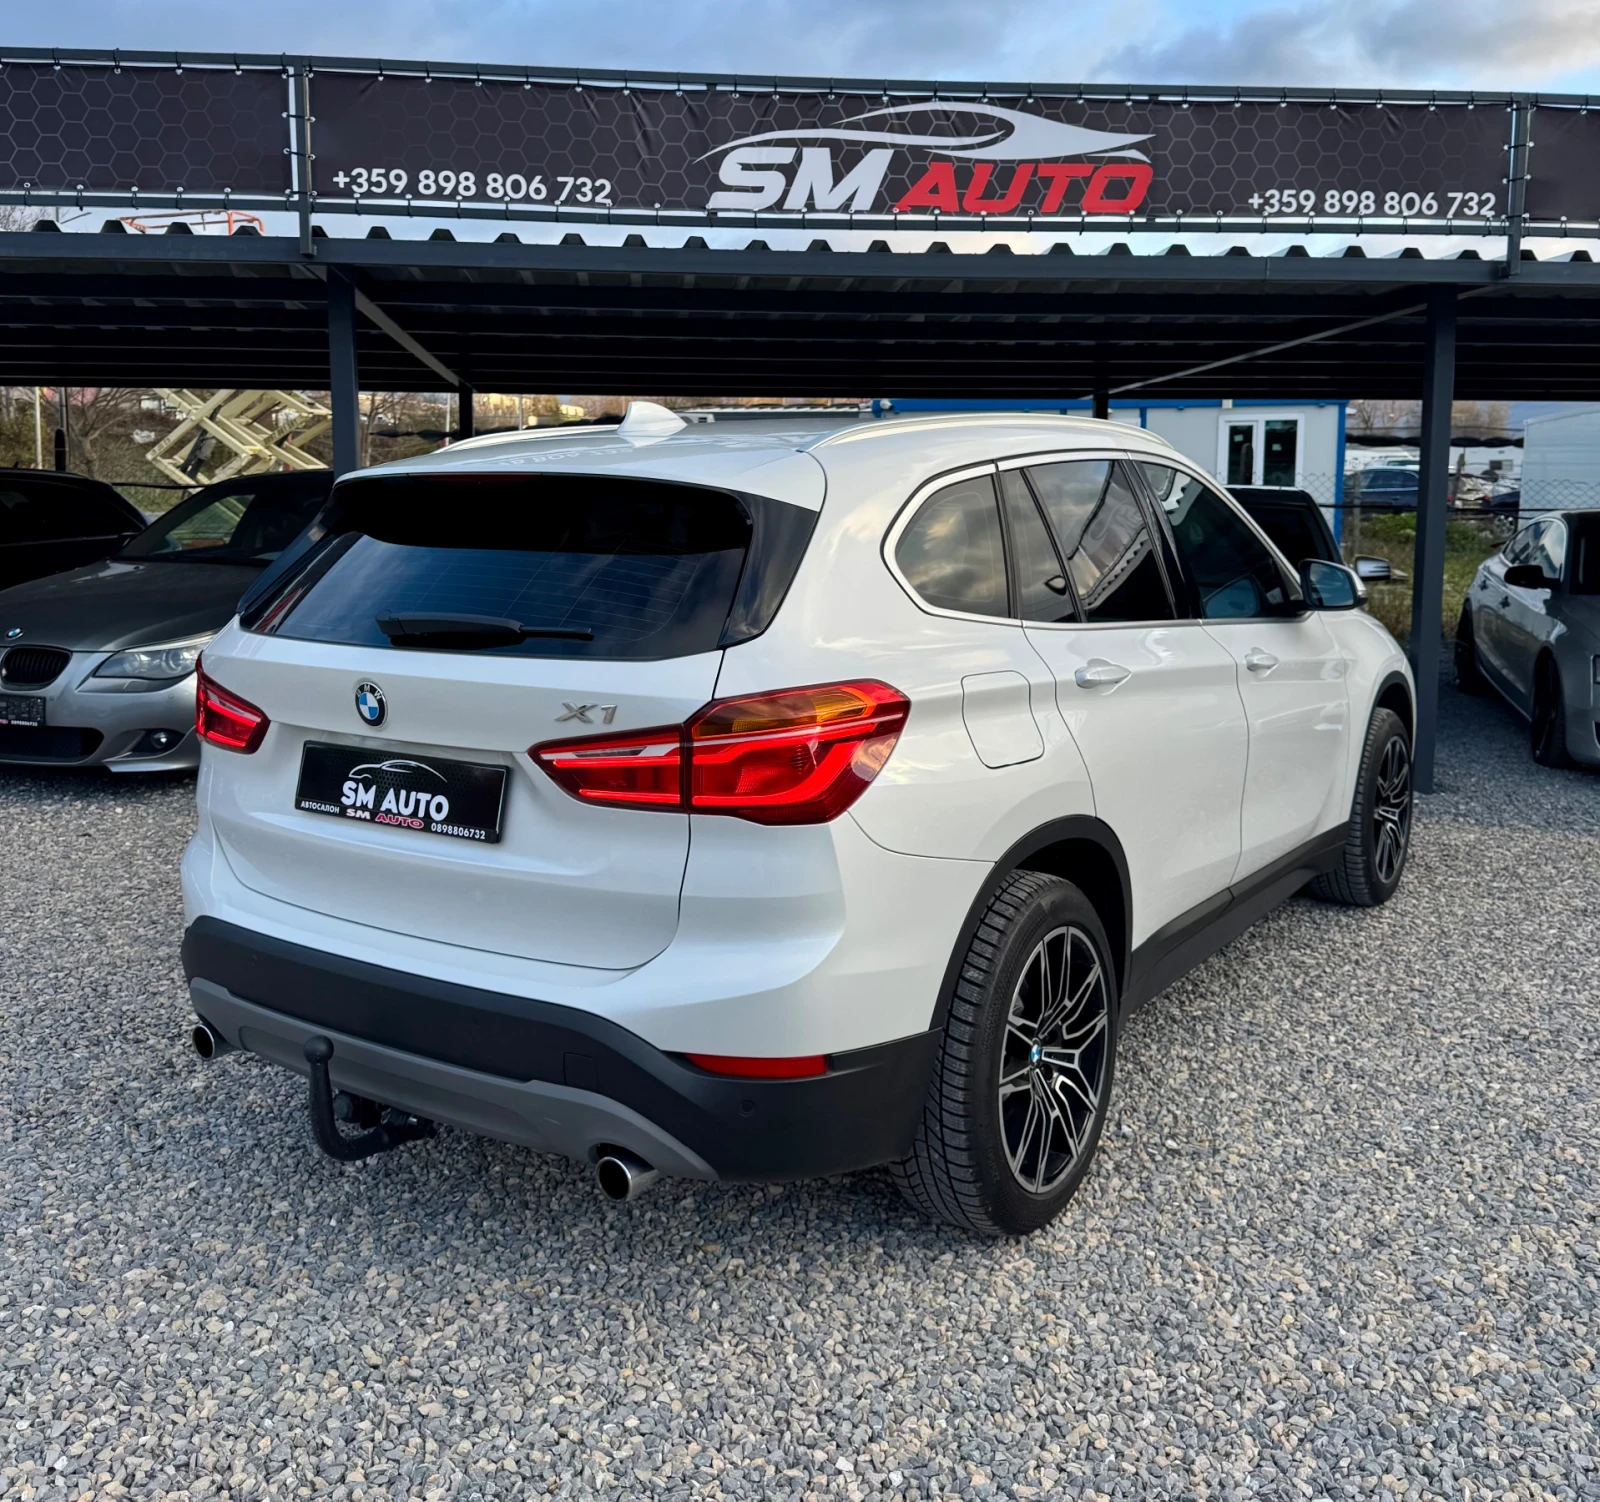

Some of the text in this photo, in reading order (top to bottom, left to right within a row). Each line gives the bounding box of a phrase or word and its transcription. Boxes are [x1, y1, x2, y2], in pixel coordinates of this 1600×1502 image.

[333, 167, 612, 205] +359 898 806 732
[708, 146, 1154, 213] SM AUTO
[1248, 189, 1496, 217] +359 898 806 732
[356, 683, 382, 700] BMW
[554, 702, 618, 724] X1
[300, 800, 340, 815] АВТОСАЛОН
[340, 780, 450, 821] SM AUTO
[346, 808, 424, 829] SM AUTO
[431, 822, 486, 840] 0898806732
